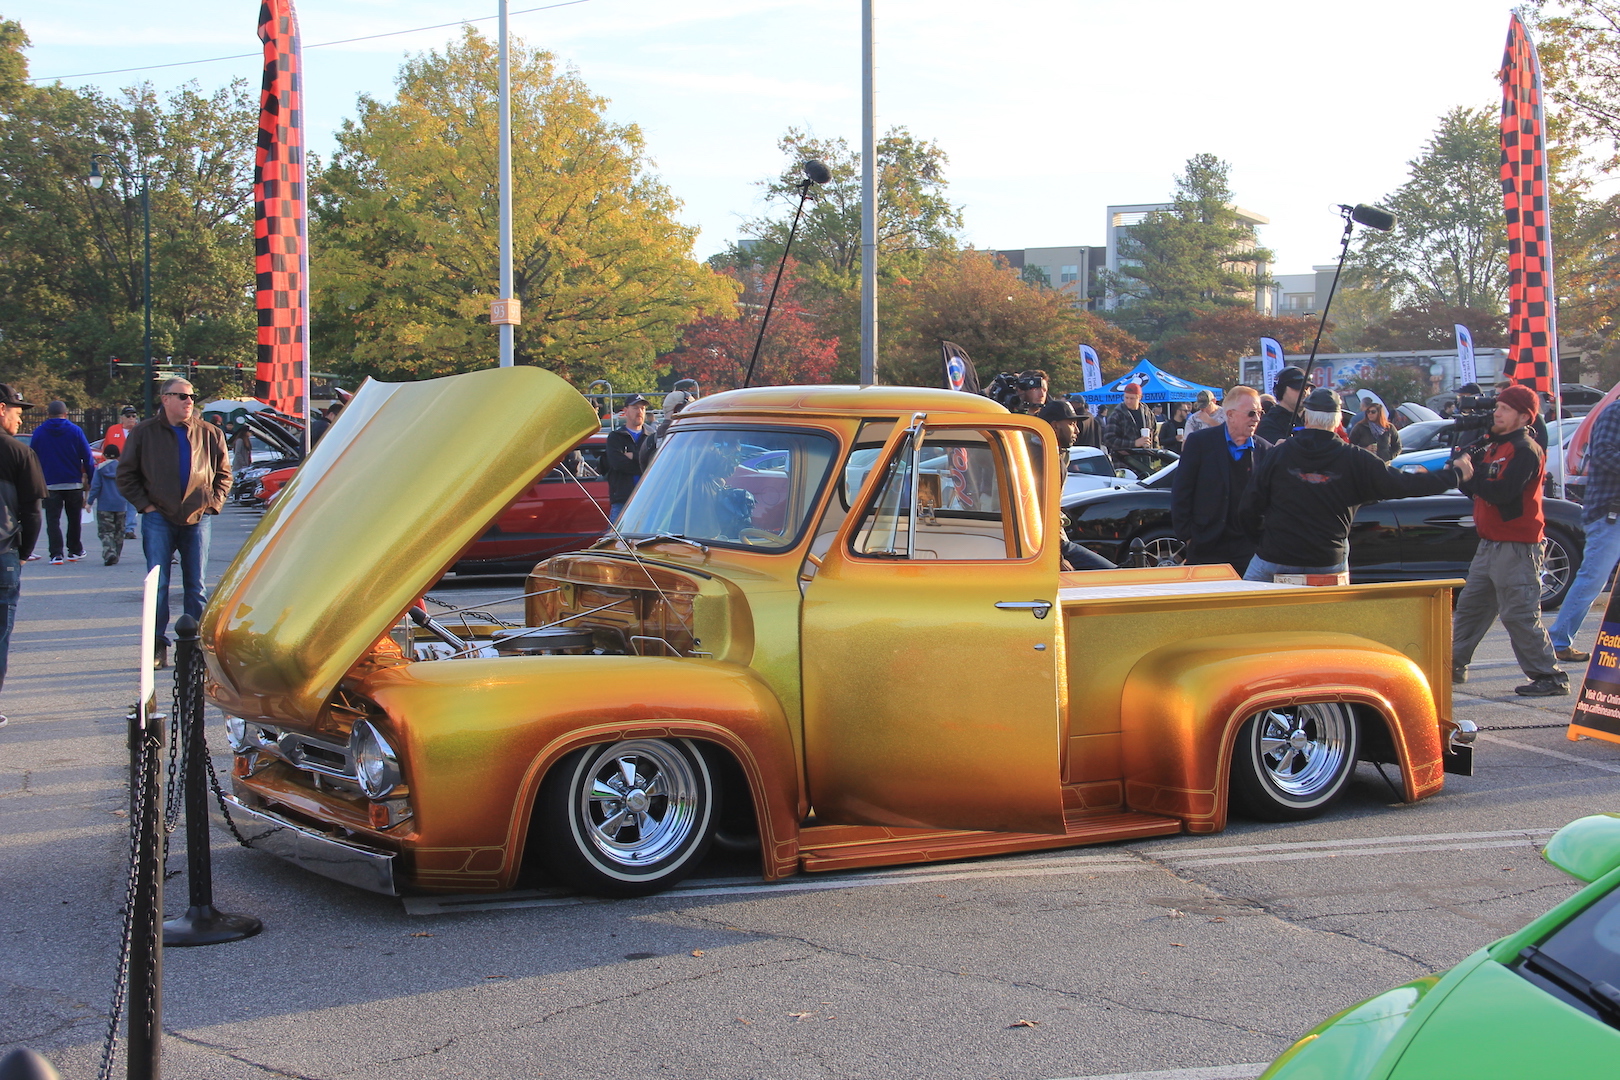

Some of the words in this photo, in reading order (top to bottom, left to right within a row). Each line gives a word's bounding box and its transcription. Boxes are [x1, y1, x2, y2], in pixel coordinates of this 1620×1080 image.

[493, 305, 505, 318] 93
[1145, 392, 1166, 401] BMW
[1598, 650, 1618, 668] This
[1586, 689, 1597, 700] Visit
[1596, 692, 1607, 702] Our
